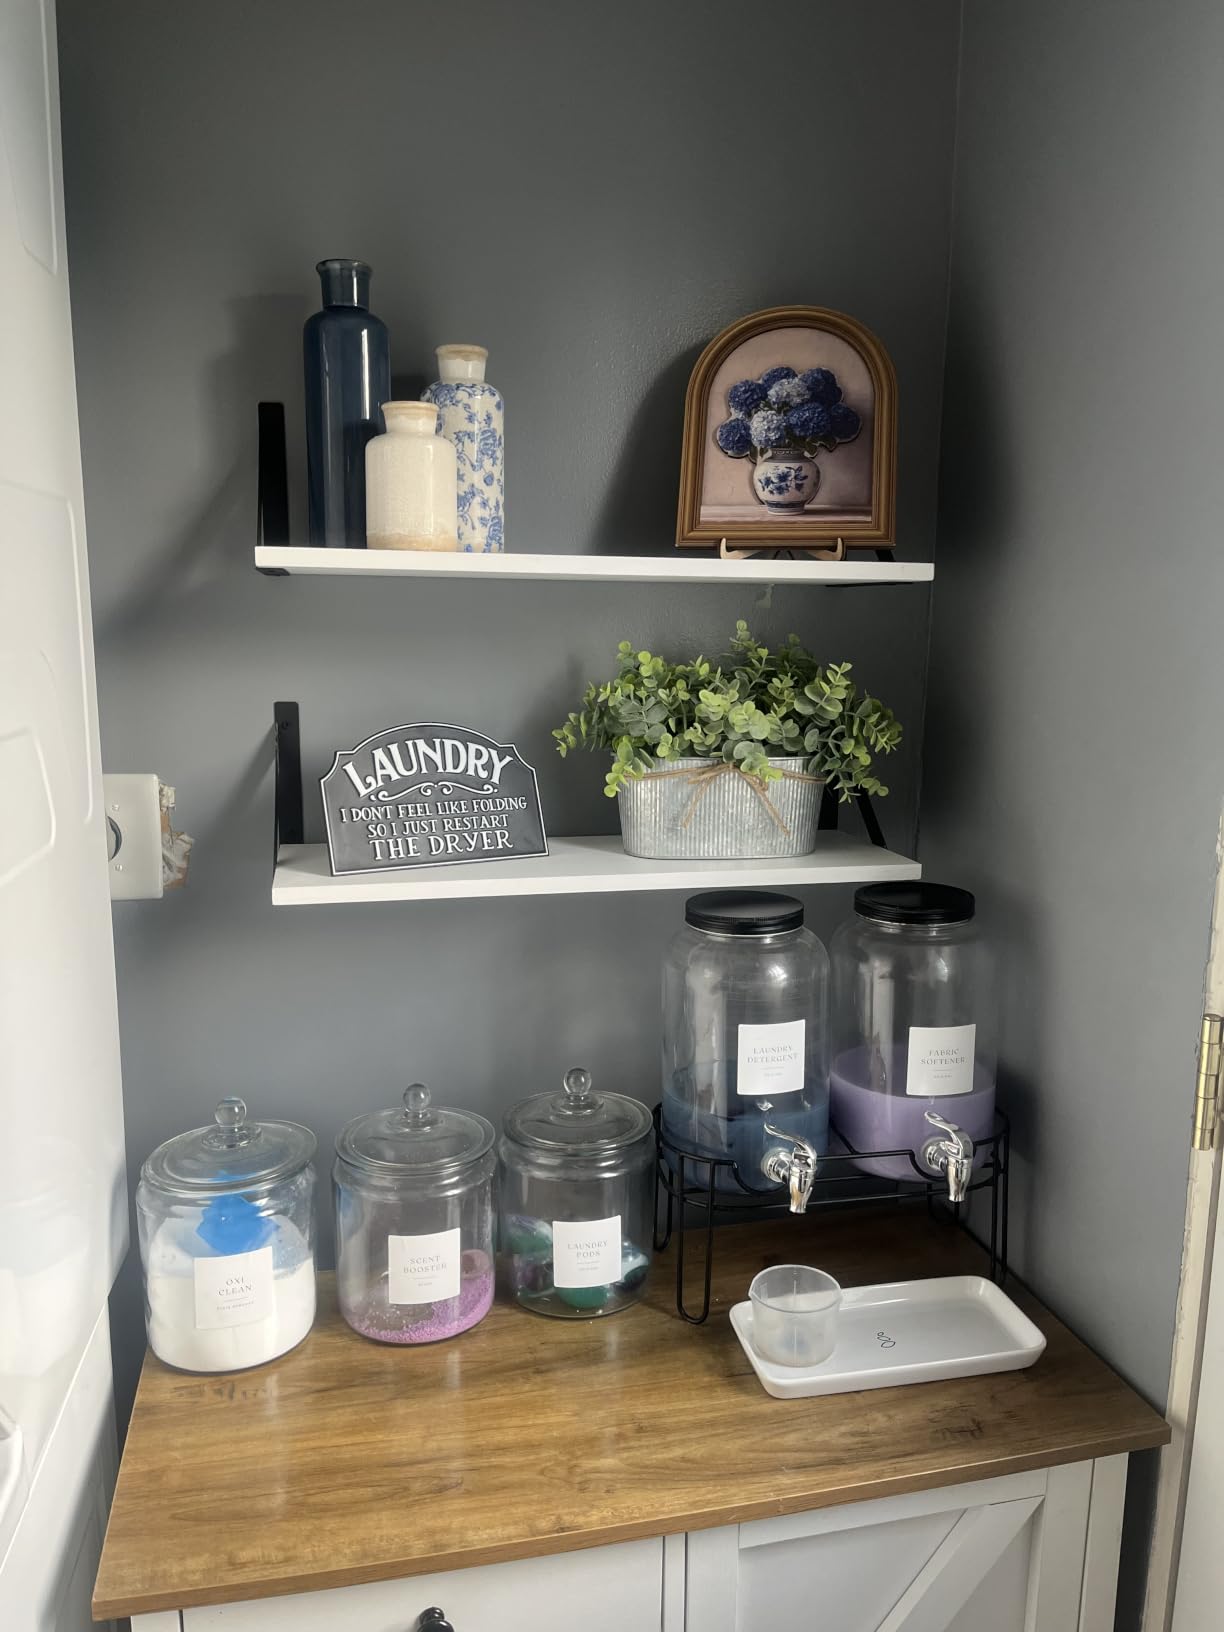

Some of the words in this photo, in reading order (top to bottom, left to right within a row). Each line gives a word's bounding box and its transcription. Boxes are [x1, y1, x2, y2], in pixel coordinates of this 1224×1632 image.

[342, 738, 513, 797] LAUNDRY
[340, 808, 347, 822] I
[398, 803, 432, 817] FEEL
[437, 800, 468, 815] LIKE
[472, 796, 527, 813] FOLDING
[368, 823, 387, 838] SO
[392, 822, 398, 836] I
[402, 819, 437, 835] JUST
[443, 814, 509, 831] RESTART
[369, 837, 421, 860] THE
[428, 829, 513, 855] DRYER
[753, 1044, 792, 1055] LAUNDRY
[929, 1048, 959, 1057] FABRIC
[747, 1053, 799, 1064] DETERGENT
[920, 1056, 968, 1065] SOFTENER
[567, 1240, 607, 1250] LAUNDRY
[576, 1250, 601, 1258] PODS
[409, 1255, 441, 1265] SCENT
[403, 1263, 448, 1273] BOOSTER
[226, 1275, 244, 1286] OXI
[218, 1284, 252, 1296] CLEAN
